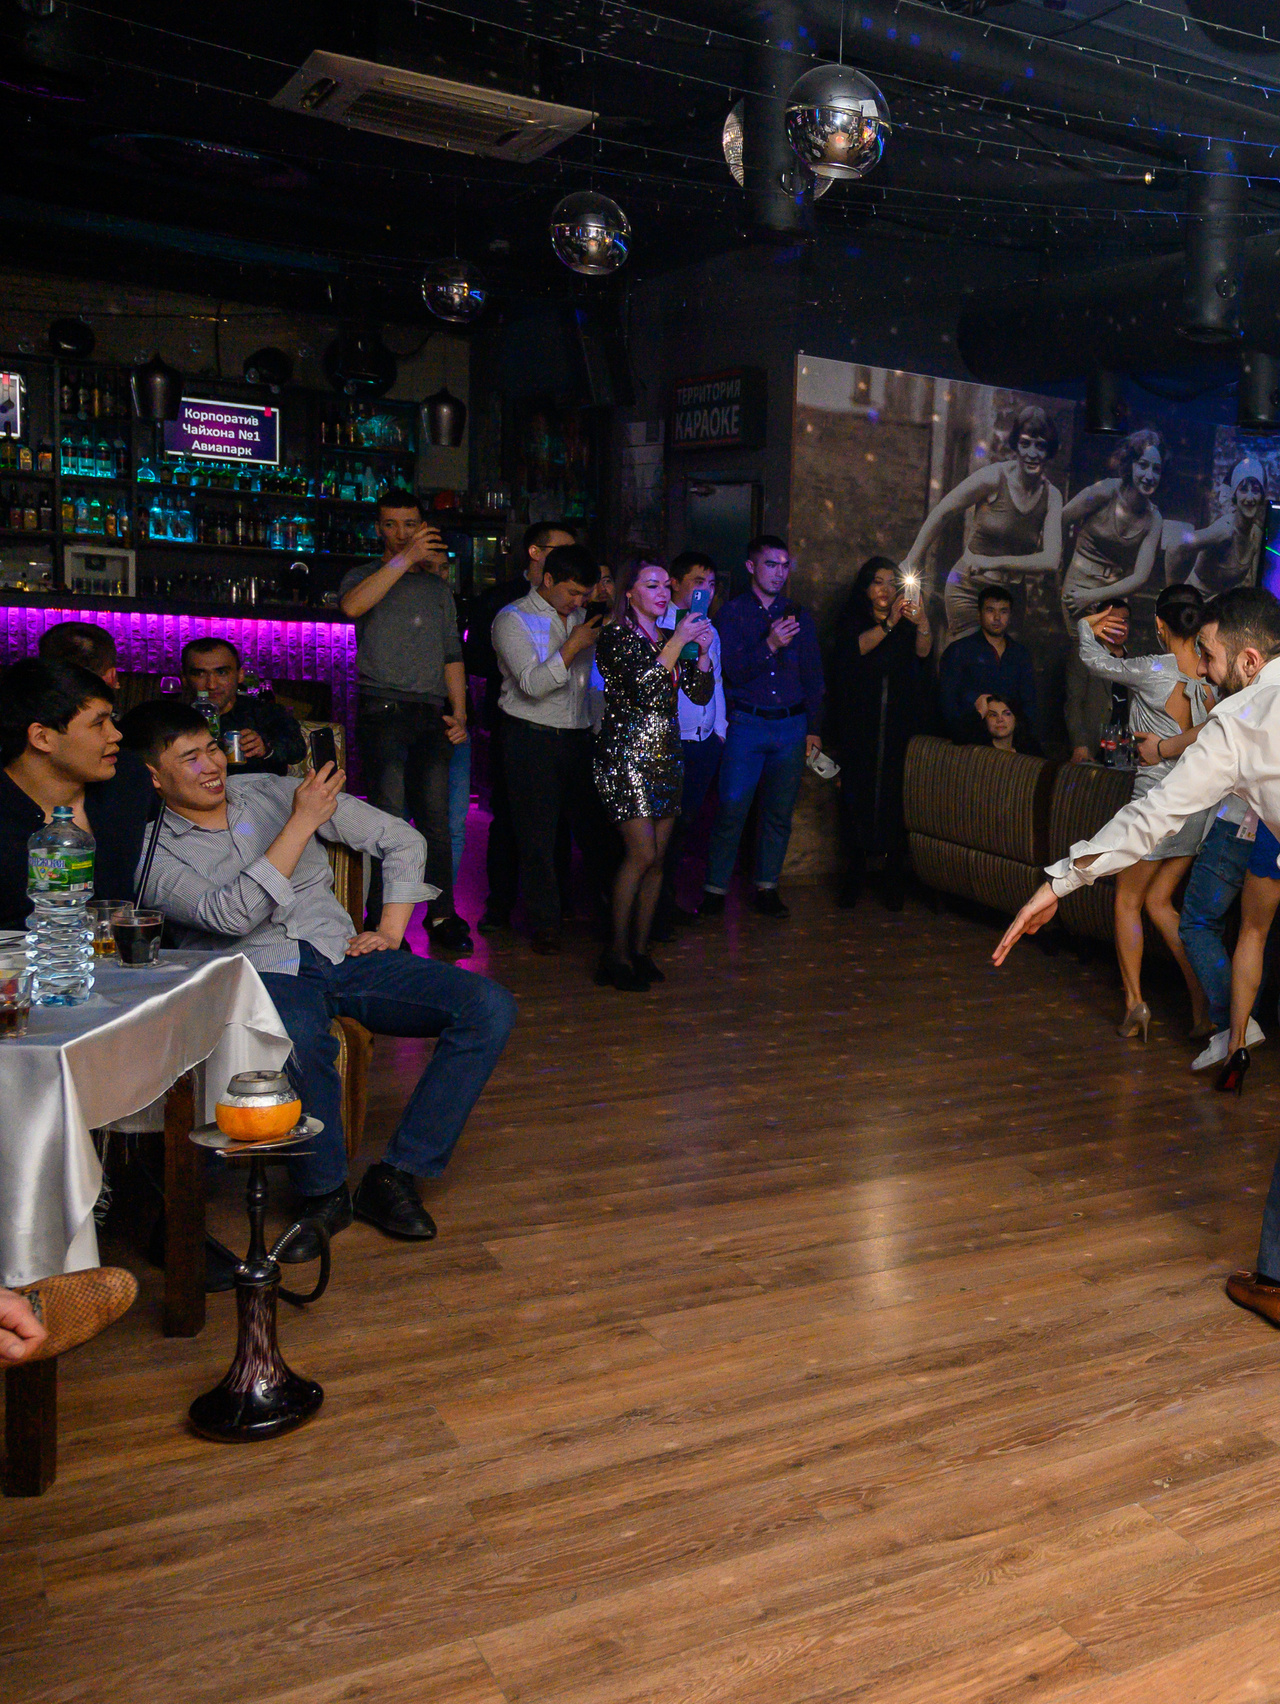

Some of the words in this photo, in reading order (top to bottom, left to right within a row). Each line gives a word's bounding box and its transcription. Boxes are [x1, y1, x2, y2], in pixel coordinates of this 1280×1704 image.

[677, 379, 741, 406] ТЕРРИТОРИЯ
[184, 407, 259, 427] Корпоратив
[675, 405, 740, 440] КАРАОКЕ
[182, 423, 235, 439] Чайхона
[238, 429, 261, 442] №1
[191, 440, 252, 456] Авиапарк
